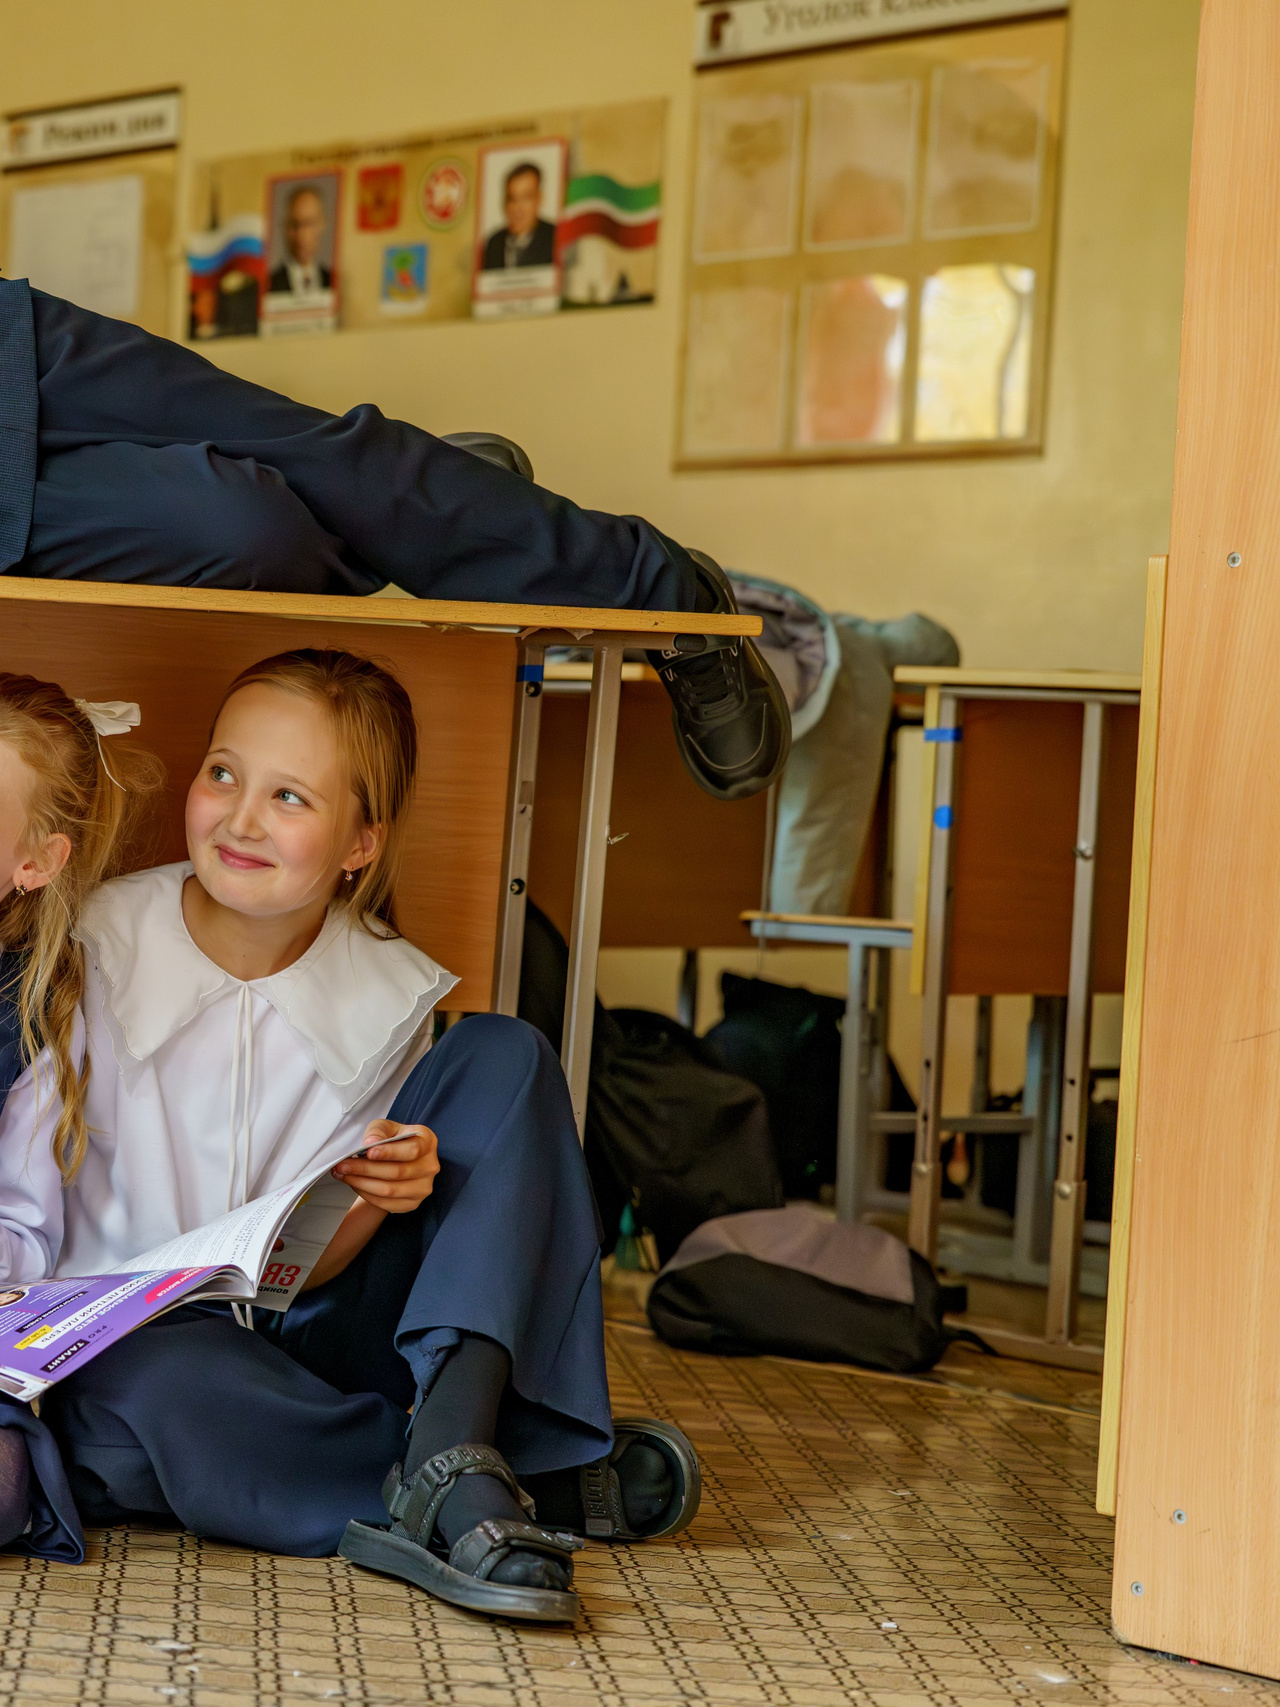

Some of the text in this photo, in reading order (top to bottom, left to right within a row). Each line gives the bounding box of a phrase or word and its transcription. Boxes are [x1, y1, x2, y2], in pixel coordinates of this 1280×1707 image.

[80, 1292, 119, 1317] ЛЕТНИЙ
[41, 1317, 79, 1343] ЛАГЕРЬ
[74, 1315, 99, 1332] ЛЕТО
[47, 1342, 85, 1371] ТАЛАНТ
